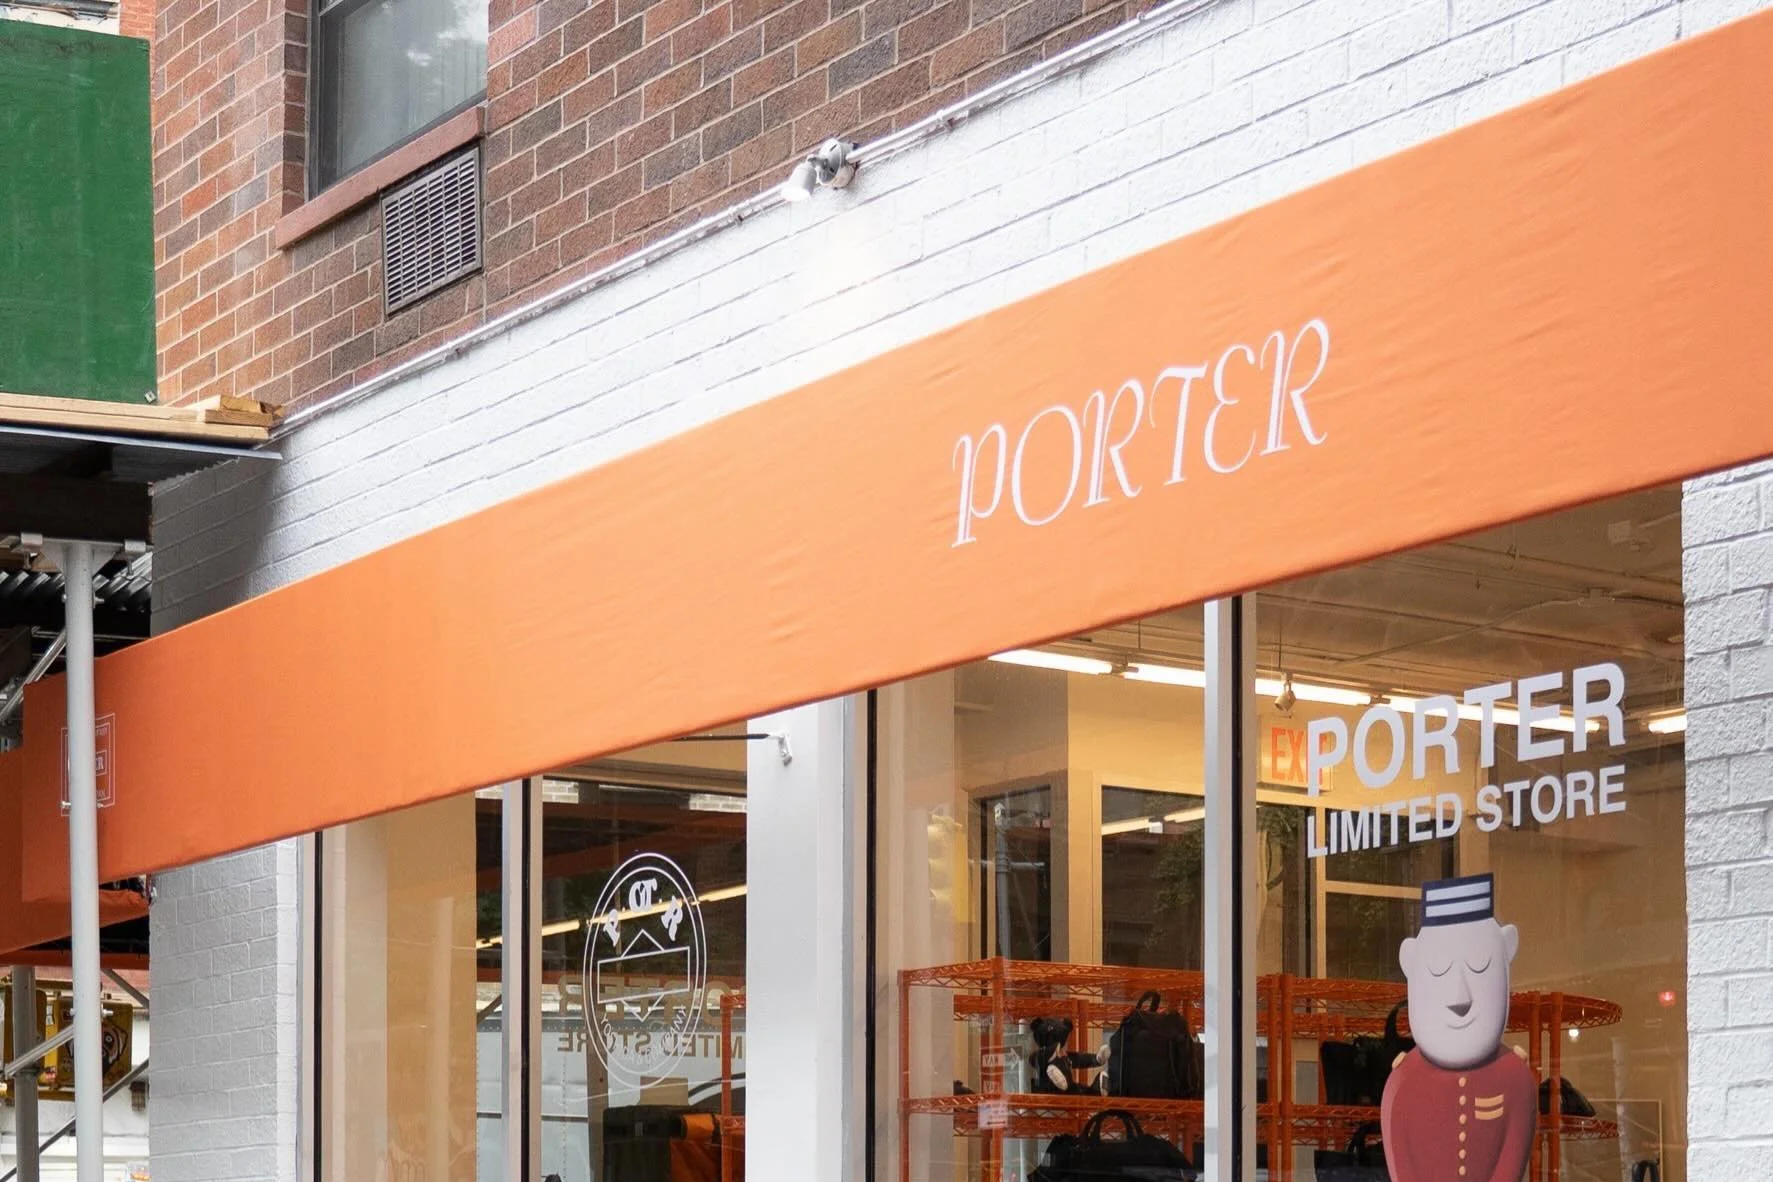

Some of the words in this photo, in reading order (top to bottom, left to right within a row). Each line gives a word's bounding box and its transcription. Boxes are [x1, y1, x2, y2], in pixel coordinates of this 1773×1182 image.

[952, 318, 1330, 548] PORTER
[1307, 662, 1627, 798] PORTER
[1307, 792, 1462, 858] LIMITED
[1475, 764, 1627, 832] STORE
